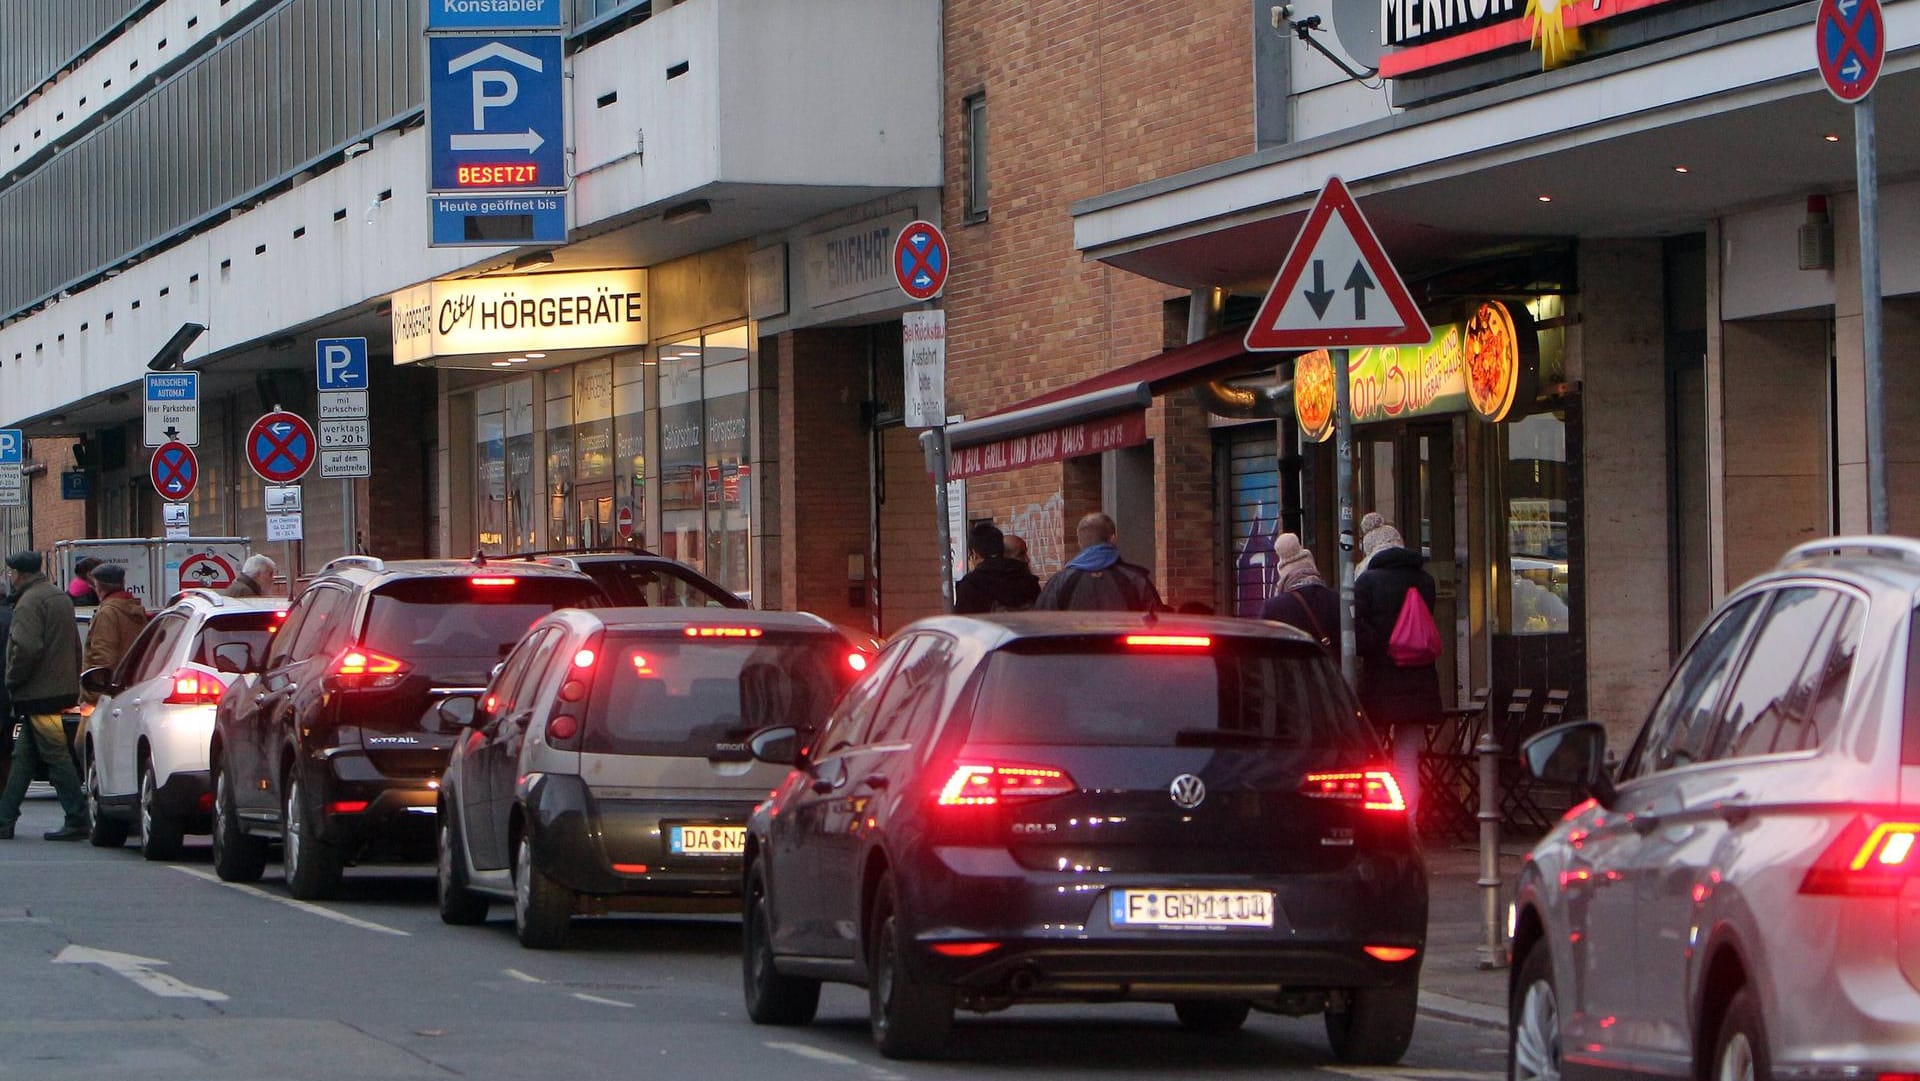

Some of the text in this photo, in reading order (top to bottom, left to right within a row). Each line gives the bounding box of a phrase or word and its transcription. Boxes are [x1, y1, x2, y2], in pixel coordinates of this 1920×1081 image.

[444, 0, 545, 12] Konstabler
[472, 70, 519, 131] P
[458, 166, 537, 184] BESETZT
[439, 199, 557, 213] Heute geöffnet bis
[827, 227, 890, 288] EINFAHRT
[438, 286, 641, 335] City HÖRGERÄTE
[325, 345, 352, 384] P
[162, 403, 196, 413] Parkschein
[322, 404, 365, 414] Parkschein
[323, 424, 366, 435] werktags
[325, 435, 332, 443] 9
[341, 434, 354, 443] 20
[356, 434, 363, 443] h
[965, 446, 981, 473] BUL
[984, 441, 1007, 470] GRILL
[1010, 436, 1028, 465] UND
[1030, 430, 1058, 461] KEBAP
[1061, 424, 1085, 455] HAUS
[344, 454, 358, 462] dem
[323, 463, 367, 473] Seitenstreifen
[715, 743, 745, 751] smart
[685, 830, 709, 848] DA
